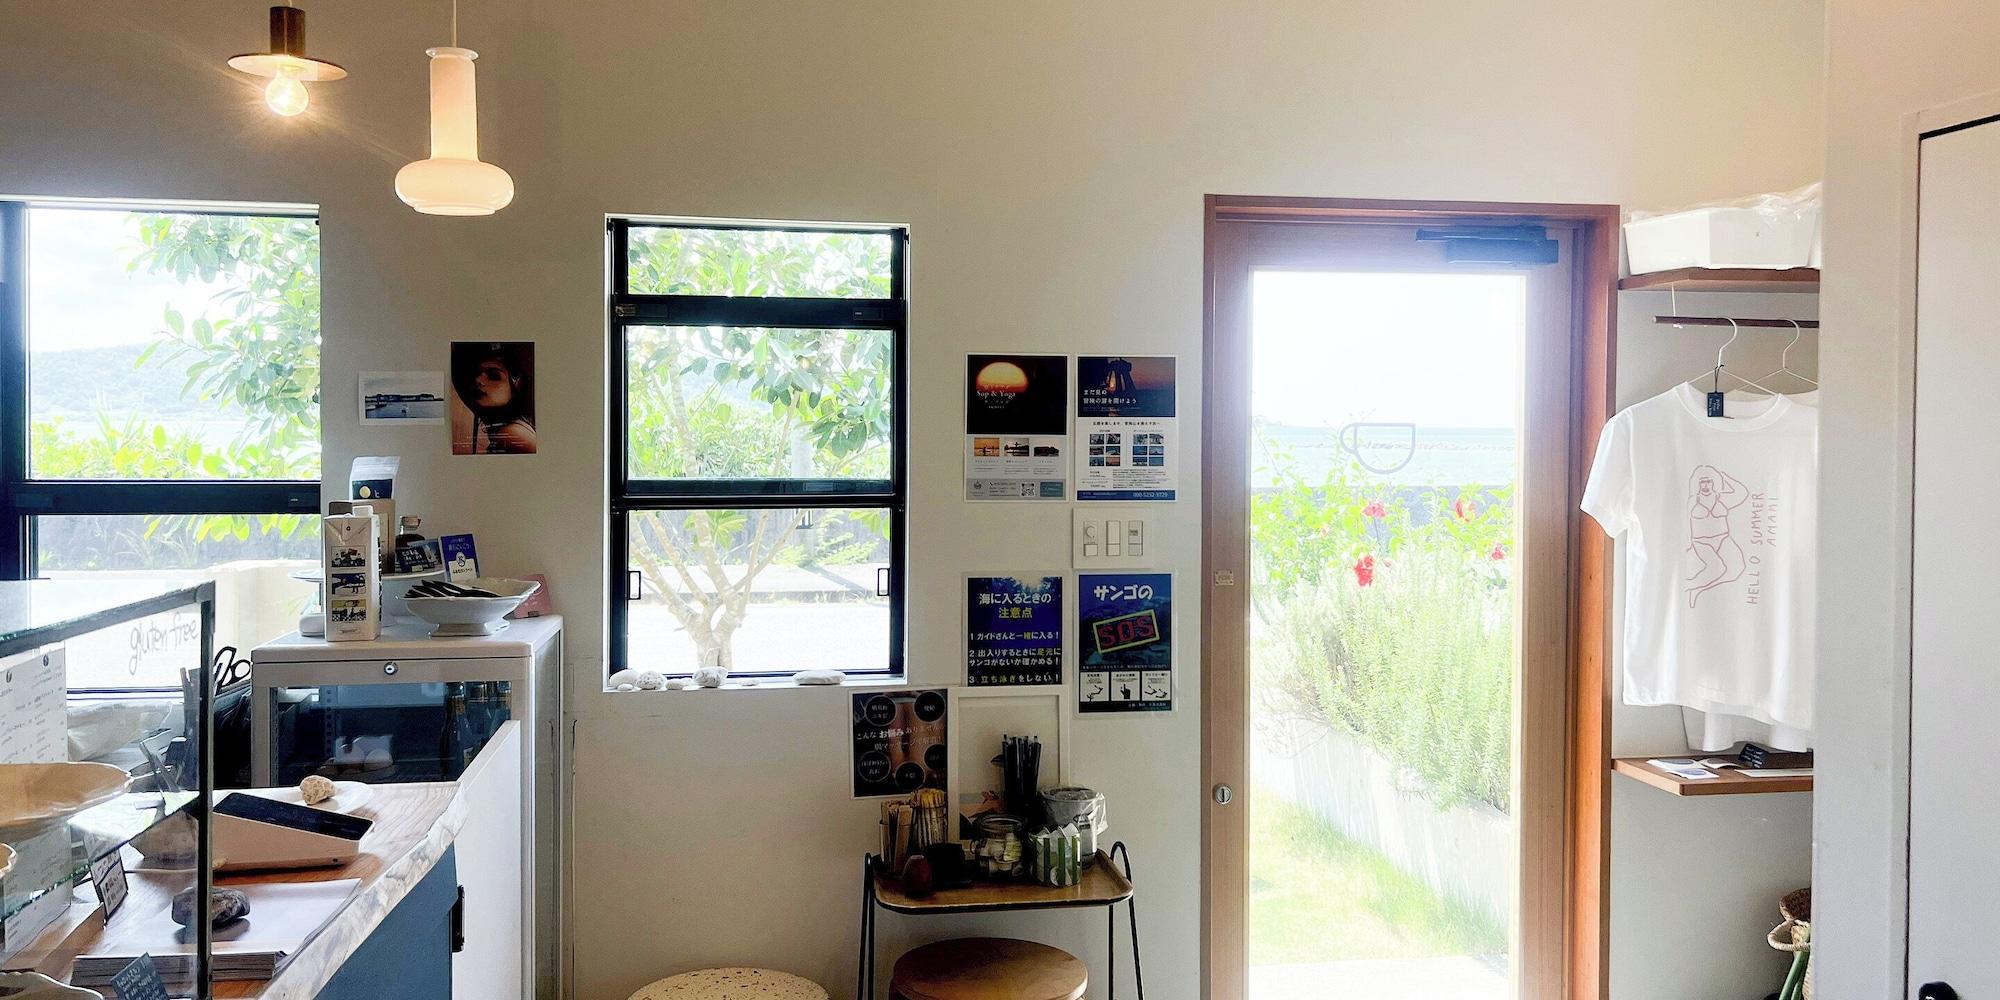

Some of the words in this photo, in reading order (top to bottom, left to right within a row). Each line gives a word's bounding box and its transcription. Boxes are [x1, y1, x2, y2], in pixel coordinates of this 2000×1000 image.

[999, 391, 1016, 400] Yoga
[1750, 492, 1765, 546] SUMMER
[1767, 497, 1779, 548] AMAMI
[1093, 584, 1153, 601] サンゴの
[1746, 555, 1761, 605] HELLO
[979, 592, 1052, 605] 海に入るときの
[998, 607, 1033, 619] 注意点
[128, 620, 168, 676] gluten
[169, 611, 199, 650] free
[1098, 615, 1155, 648] SOS
